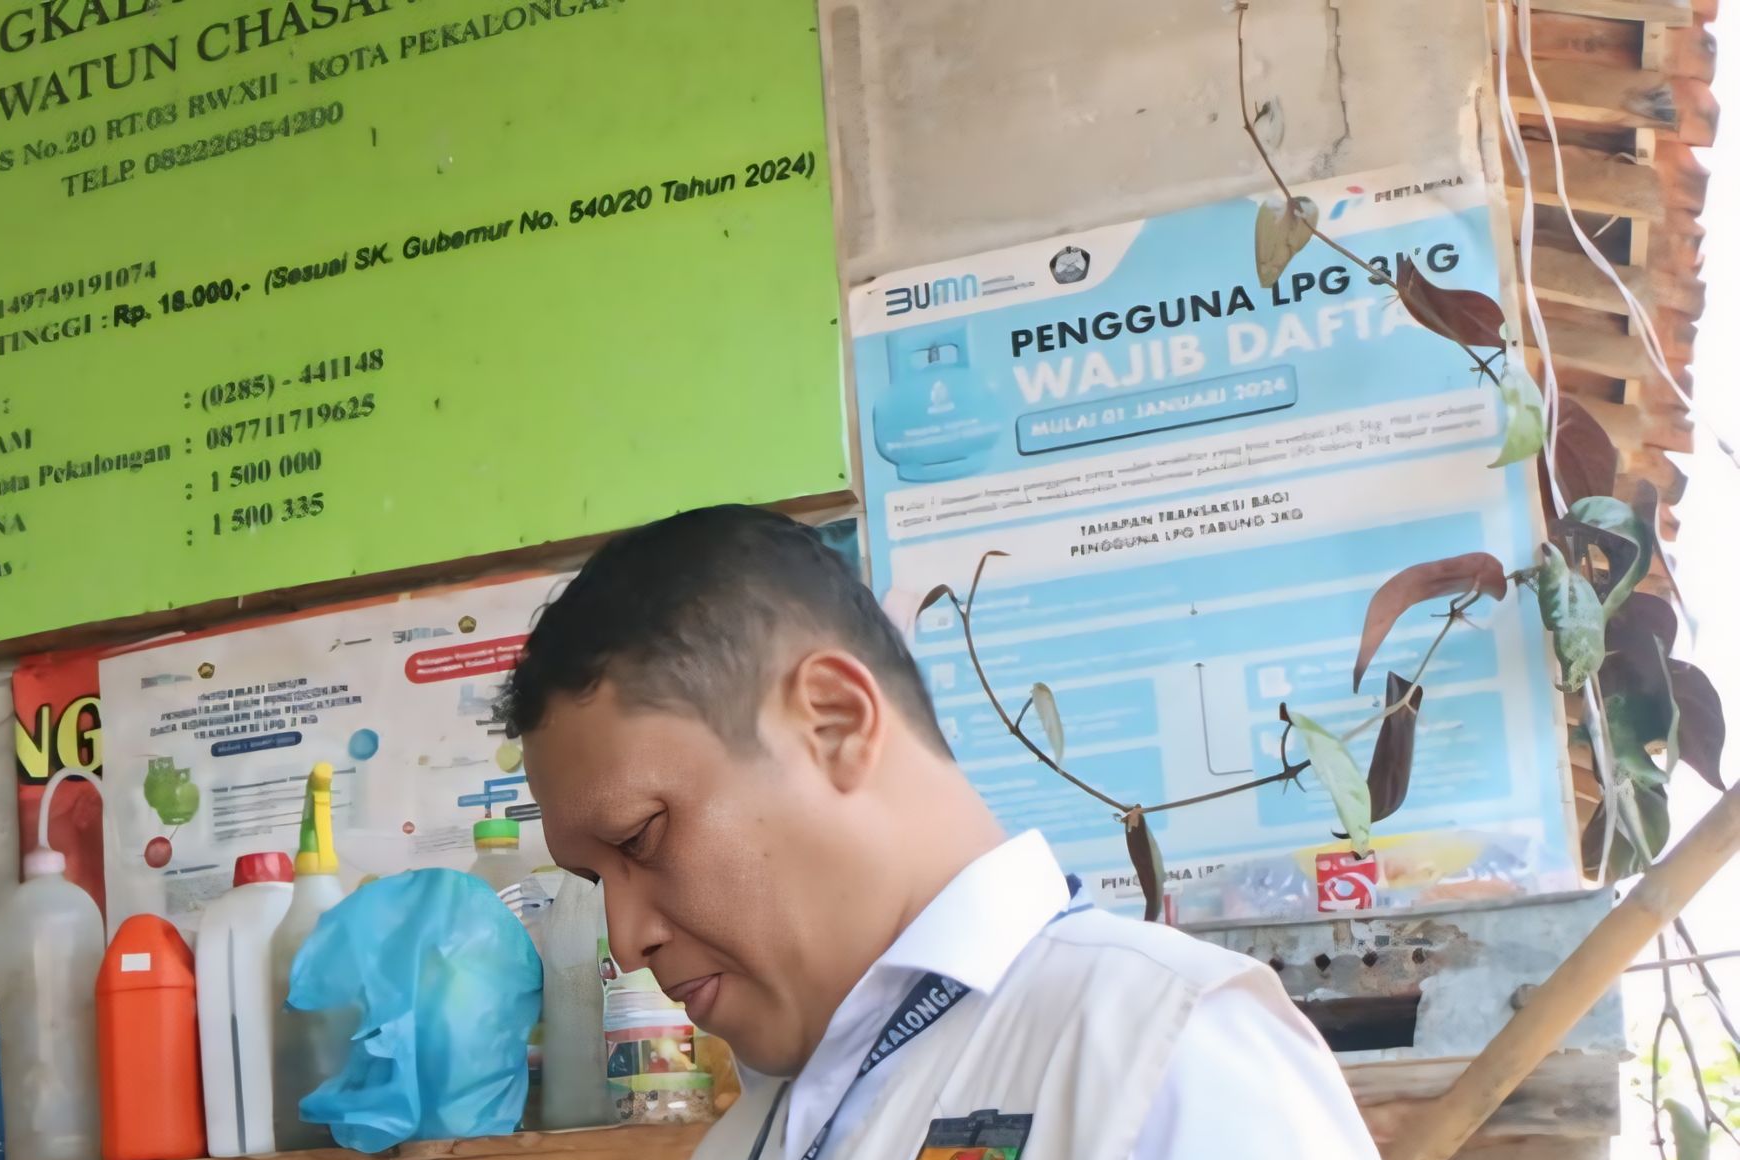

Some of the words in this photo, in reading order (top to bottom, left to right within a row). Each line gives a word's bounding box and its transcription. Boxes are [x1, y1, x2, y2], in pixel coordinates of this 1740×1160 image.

[308, 43, 389, 84] KOTA
[402, 219, 515, 260] Gubernur
[569, 184, 653, 225] 540/20
[661, 174, 736, 204] Tahun
[744, 150, 816, 189] 2024)
[1010, 285, 1256, 358] PENGGUNA
[1011, 332, 1208, 405] WAJIB
[1226, 297, 1422, 366] DAFTA
[201, 373, 276, 414] (0285)
[299, 348, 385, 385] 441148
[1031, 412, 1098, 437] MULAI
[1132, 387, 1227, 420] JANUARI
[1233, 377, 1288, 401] 2024
[38, 443, 171, 488] Pekalongan
[205, 392, 377, 451] 087711719625
[229, 458, 272, 489] 500
[279, 448, 322, 478] 000
[230, 501, 273, 532] 500
[280, 492, 325, 522] 335
